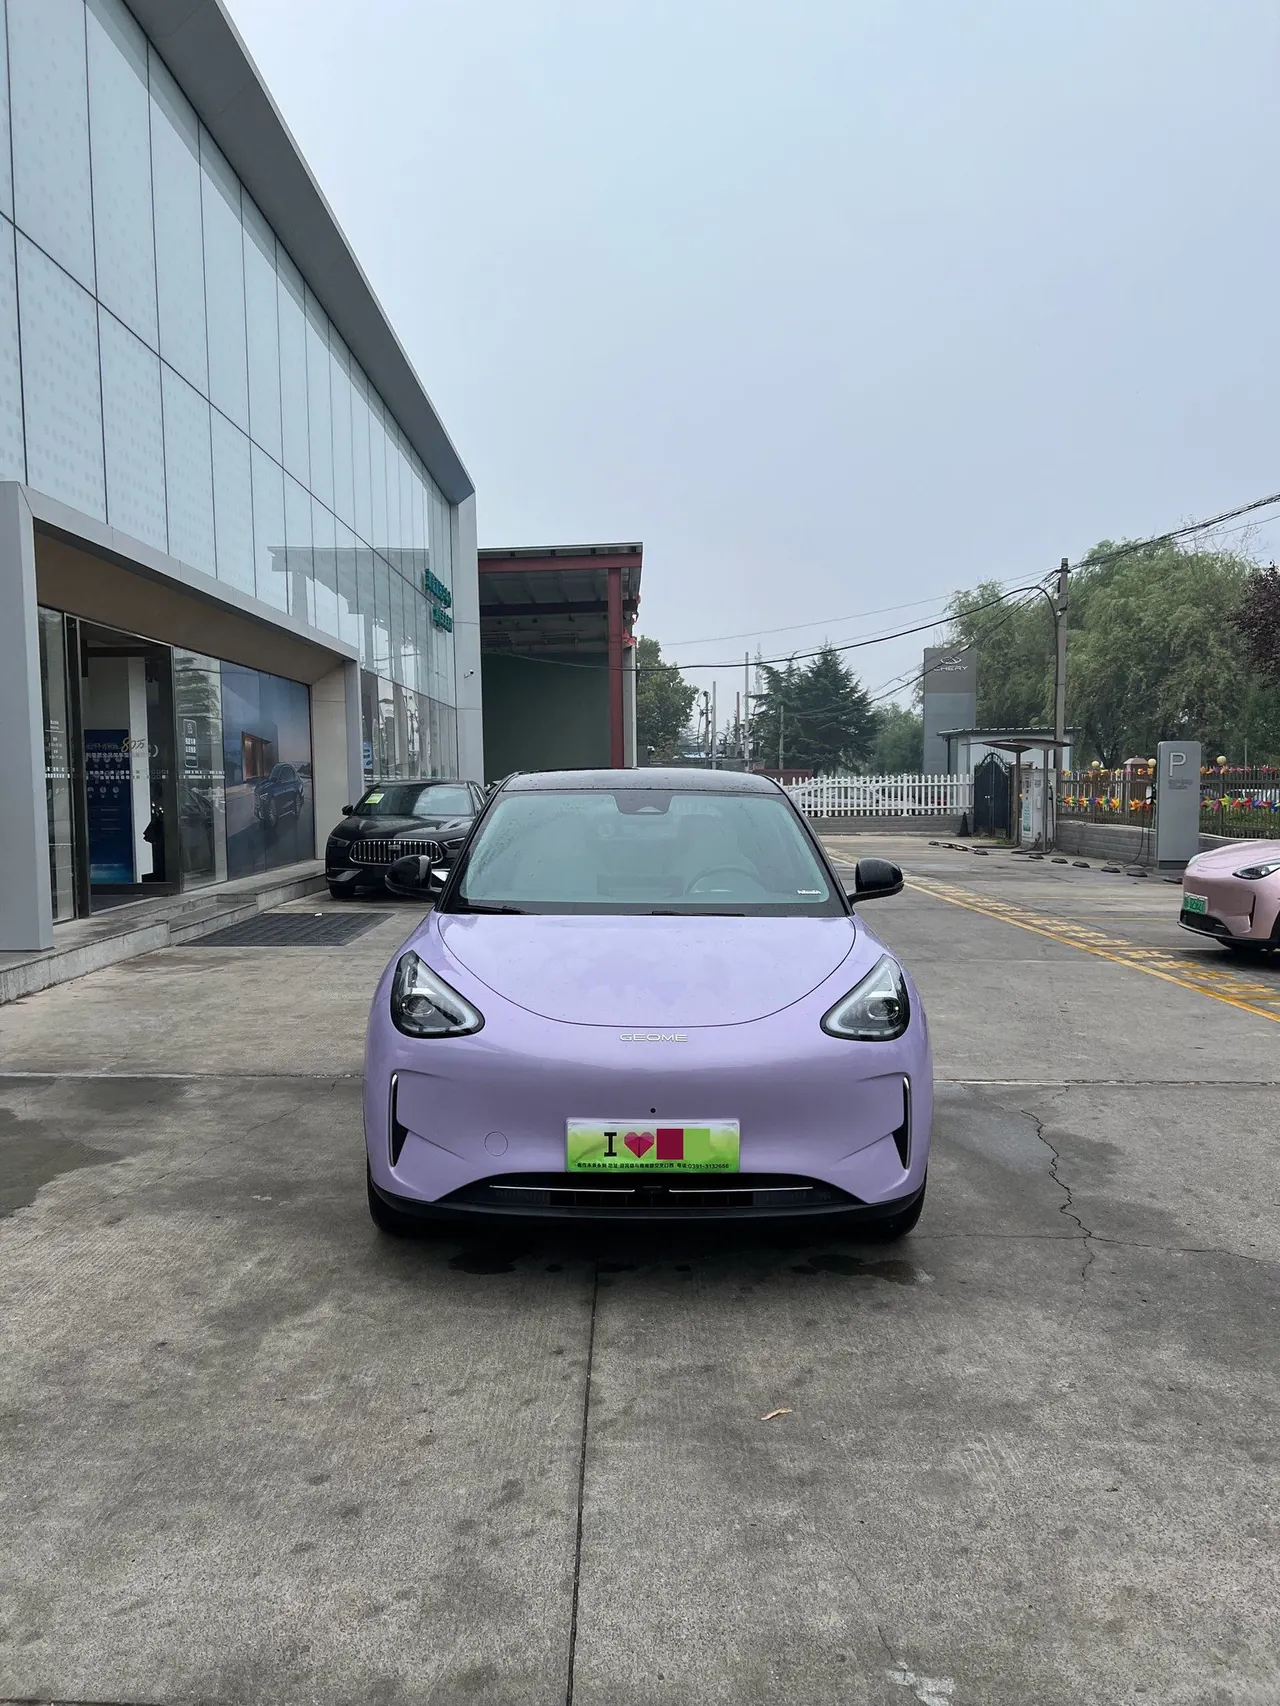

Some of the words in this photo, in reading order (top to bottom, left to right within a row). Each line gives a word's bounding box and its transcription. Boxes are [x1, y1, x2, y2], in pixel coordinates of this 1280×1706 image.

[1169, 752, 1187, 777] P
[619, 1033, 688, 1043] GEOME
[603, 1131, 617, 1157] I
